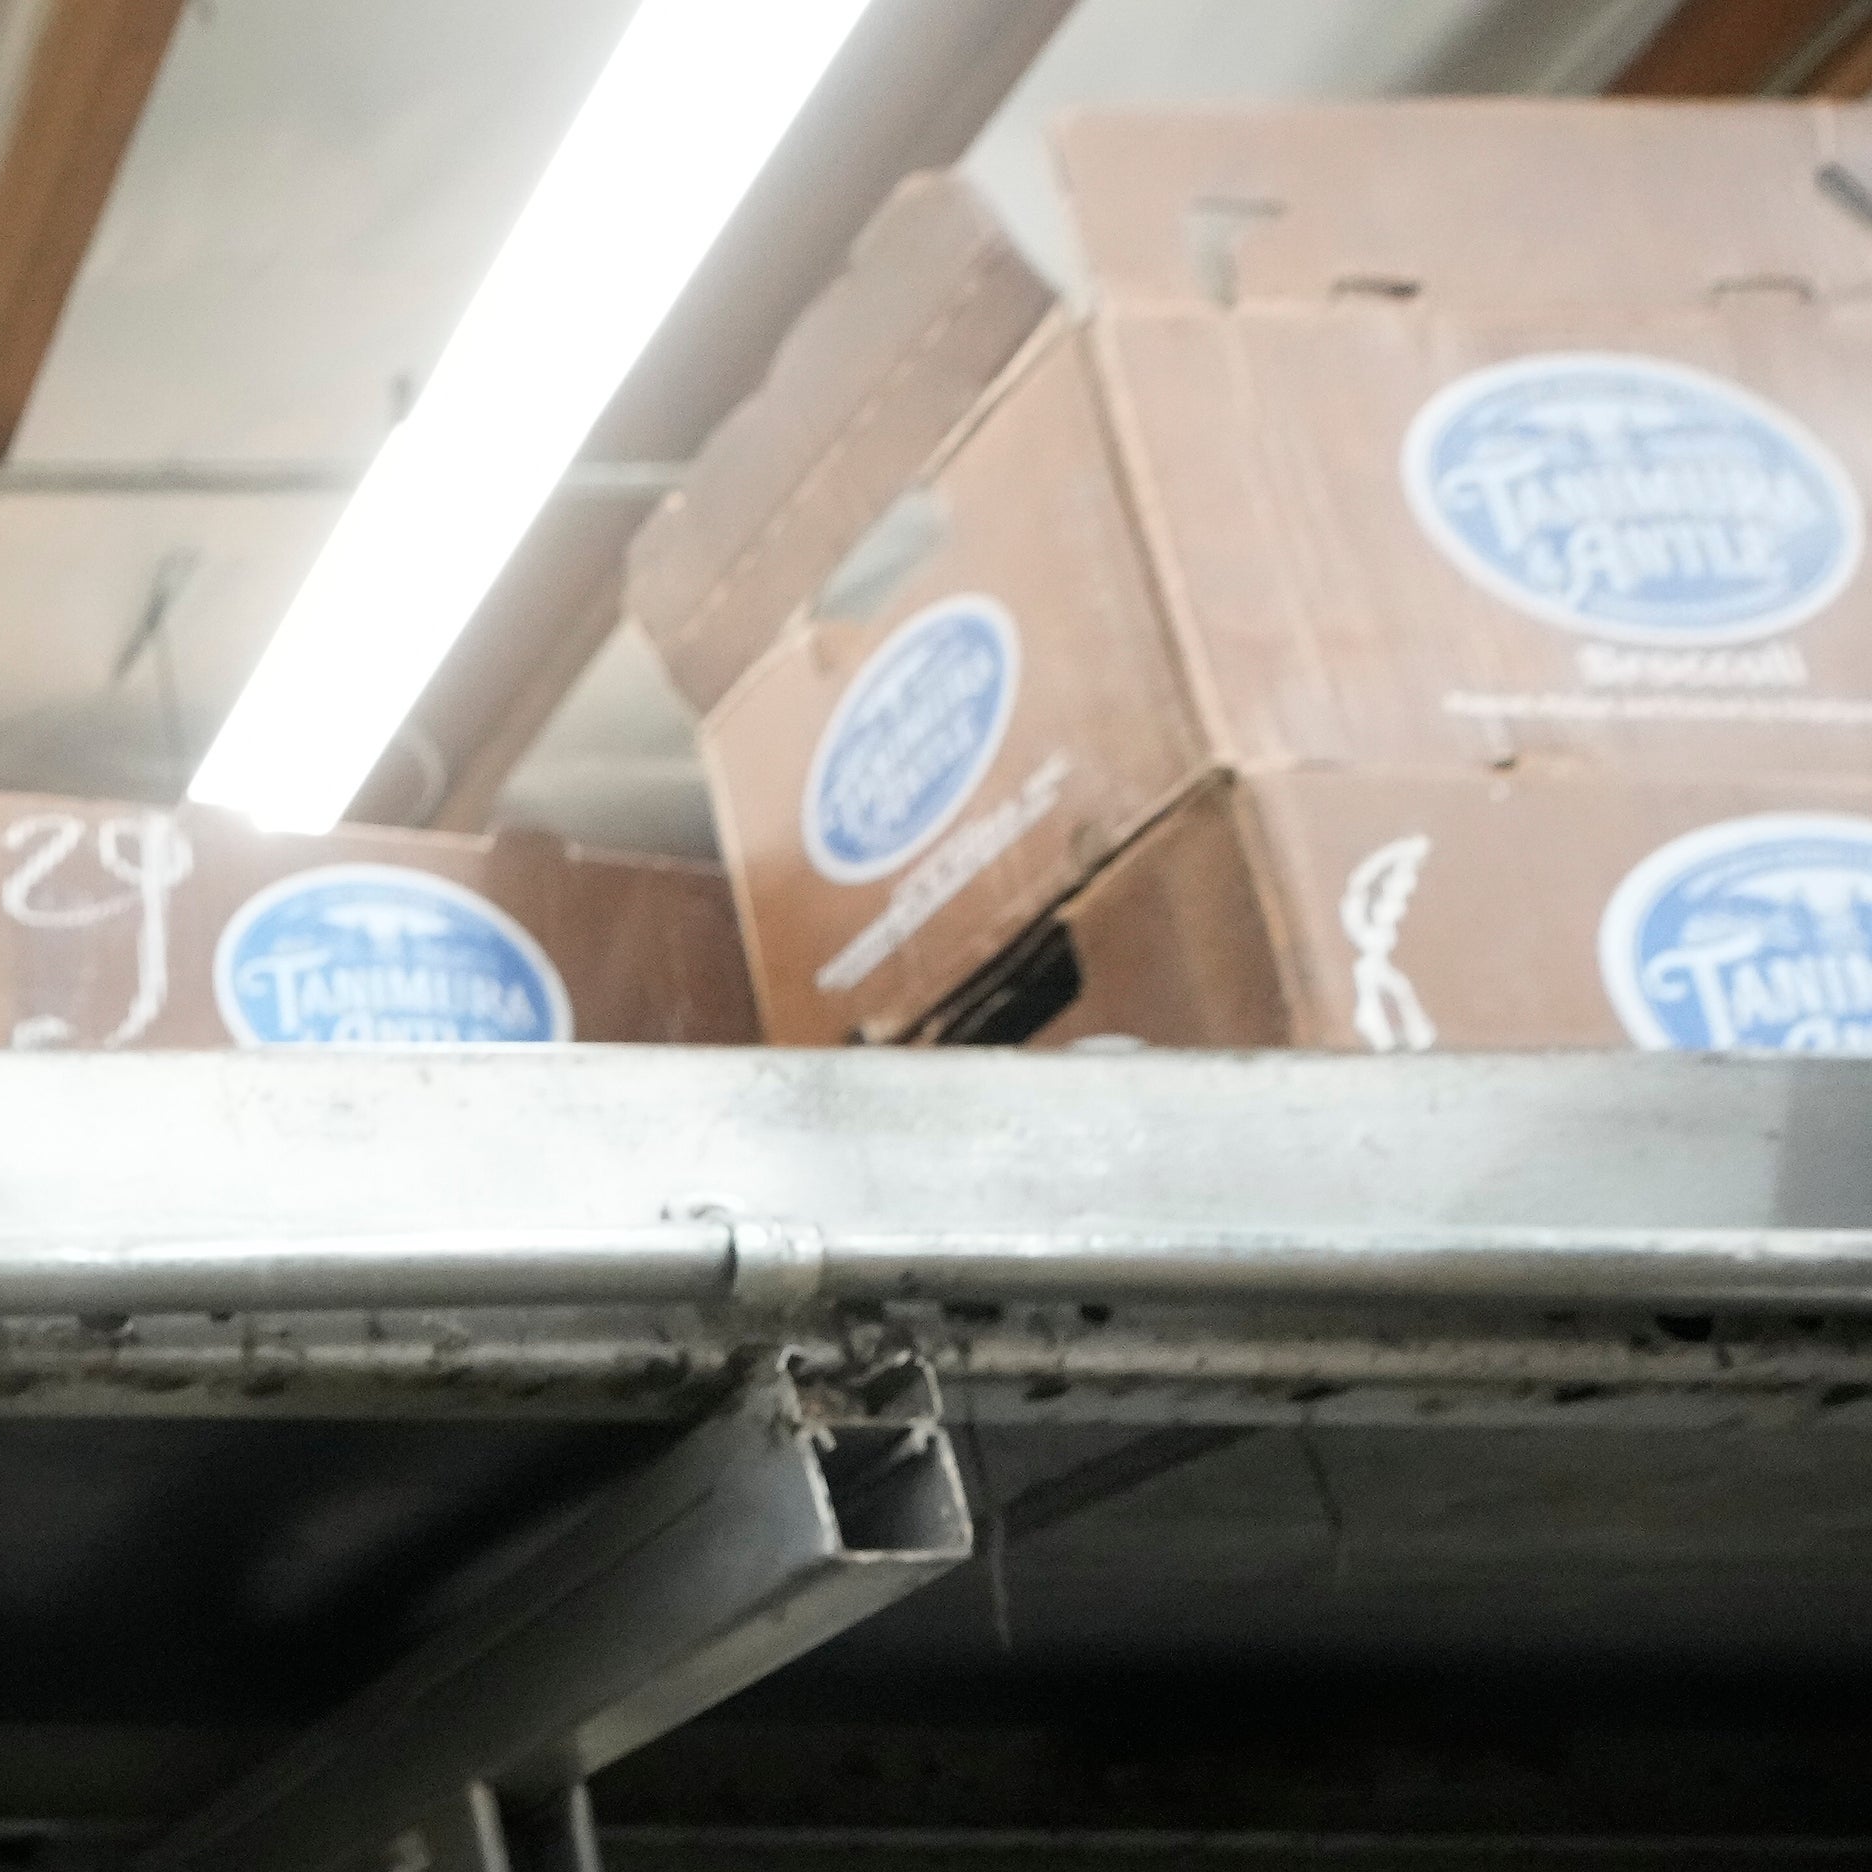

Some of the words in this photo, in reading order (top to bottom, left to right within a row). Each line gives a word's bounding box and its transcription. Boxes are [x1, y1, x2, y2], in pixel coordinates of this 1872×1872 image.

[1437, 449, 1826, 555] TANIMURA
[1556, 522, 1788, 610] ANTLE
[235, 948, 540, 1036] TANIMURA
